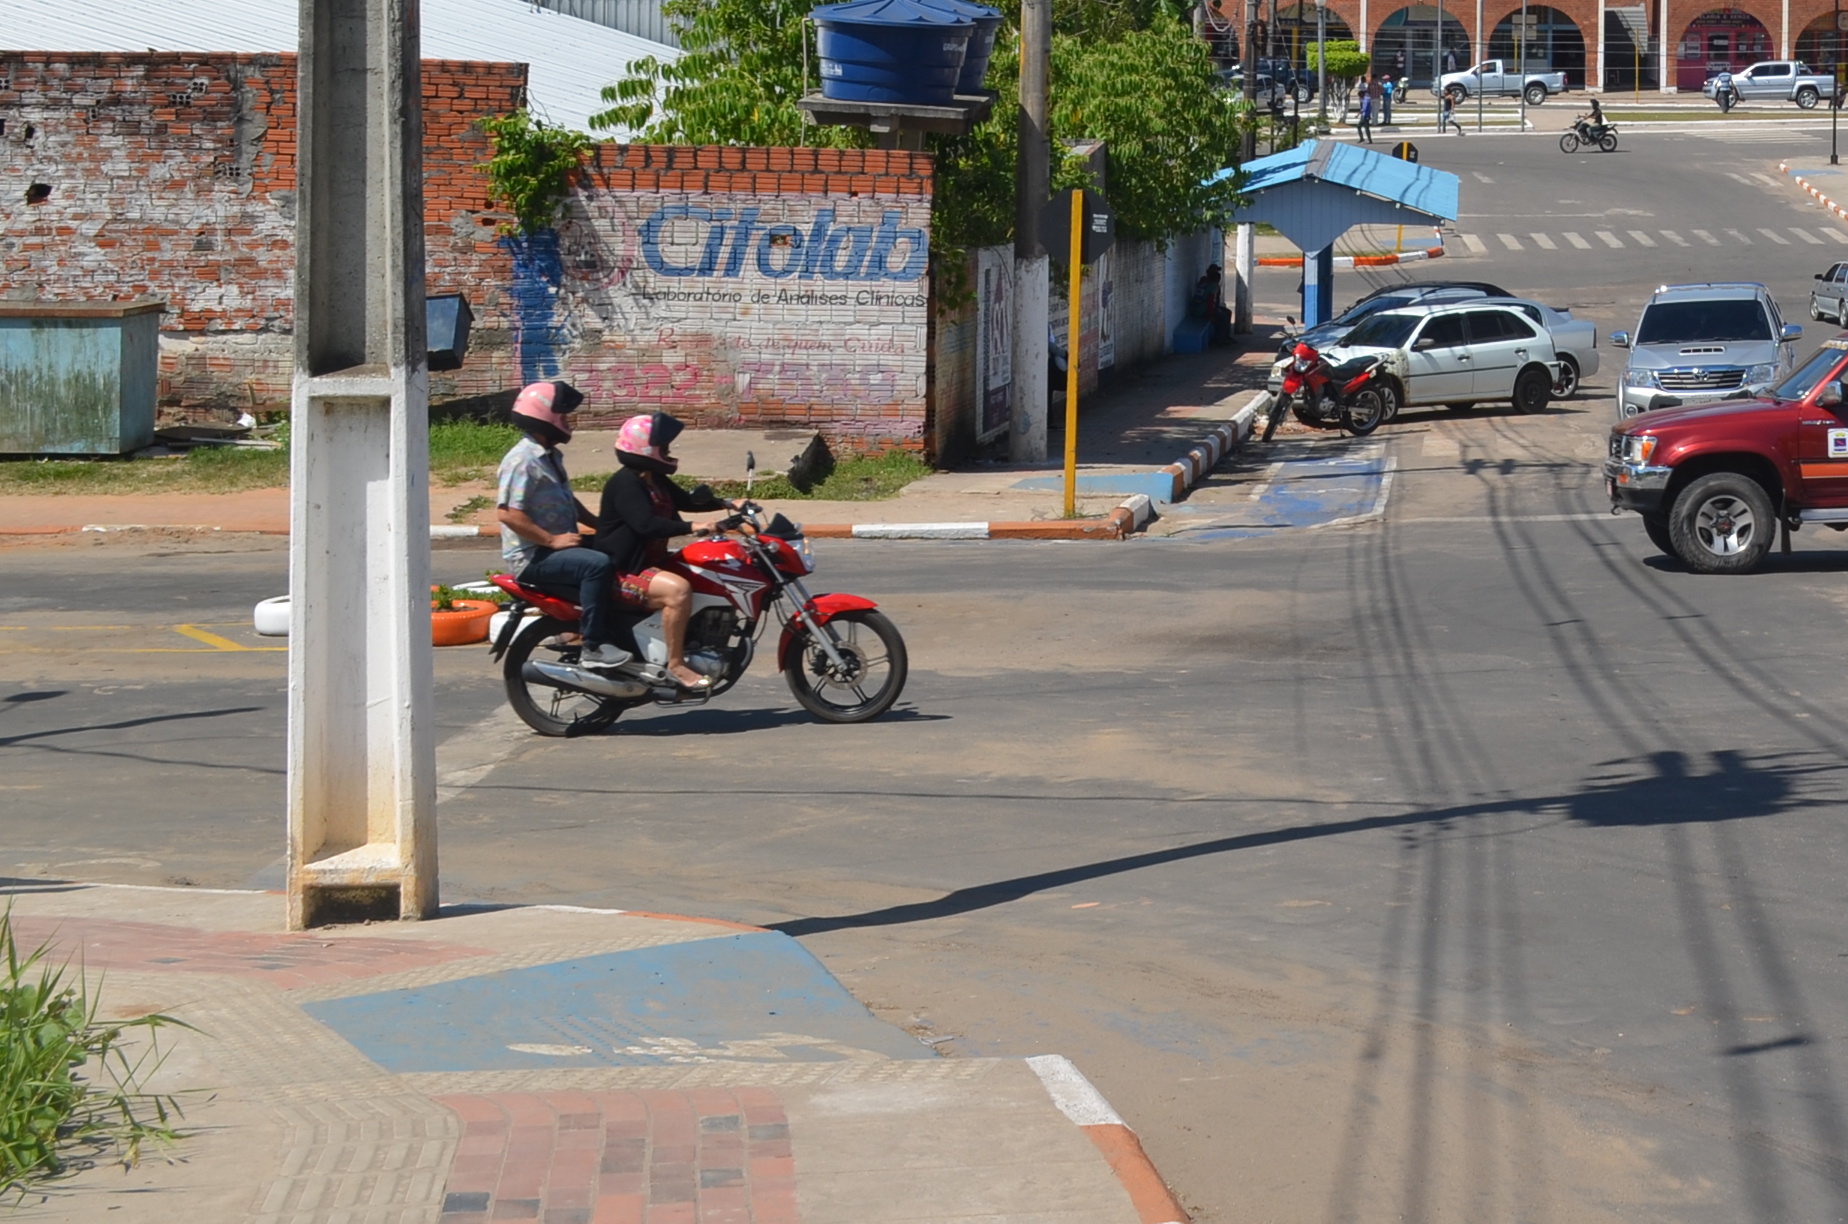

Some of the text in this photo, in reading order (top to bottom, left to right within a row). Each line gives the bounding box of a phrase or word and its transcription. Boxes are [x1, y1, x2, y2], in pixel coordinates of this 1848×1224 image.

[637, 204, 932, 282] Citolab
[642, 283, 928, 308] Laboratório de Análises Clínicas
